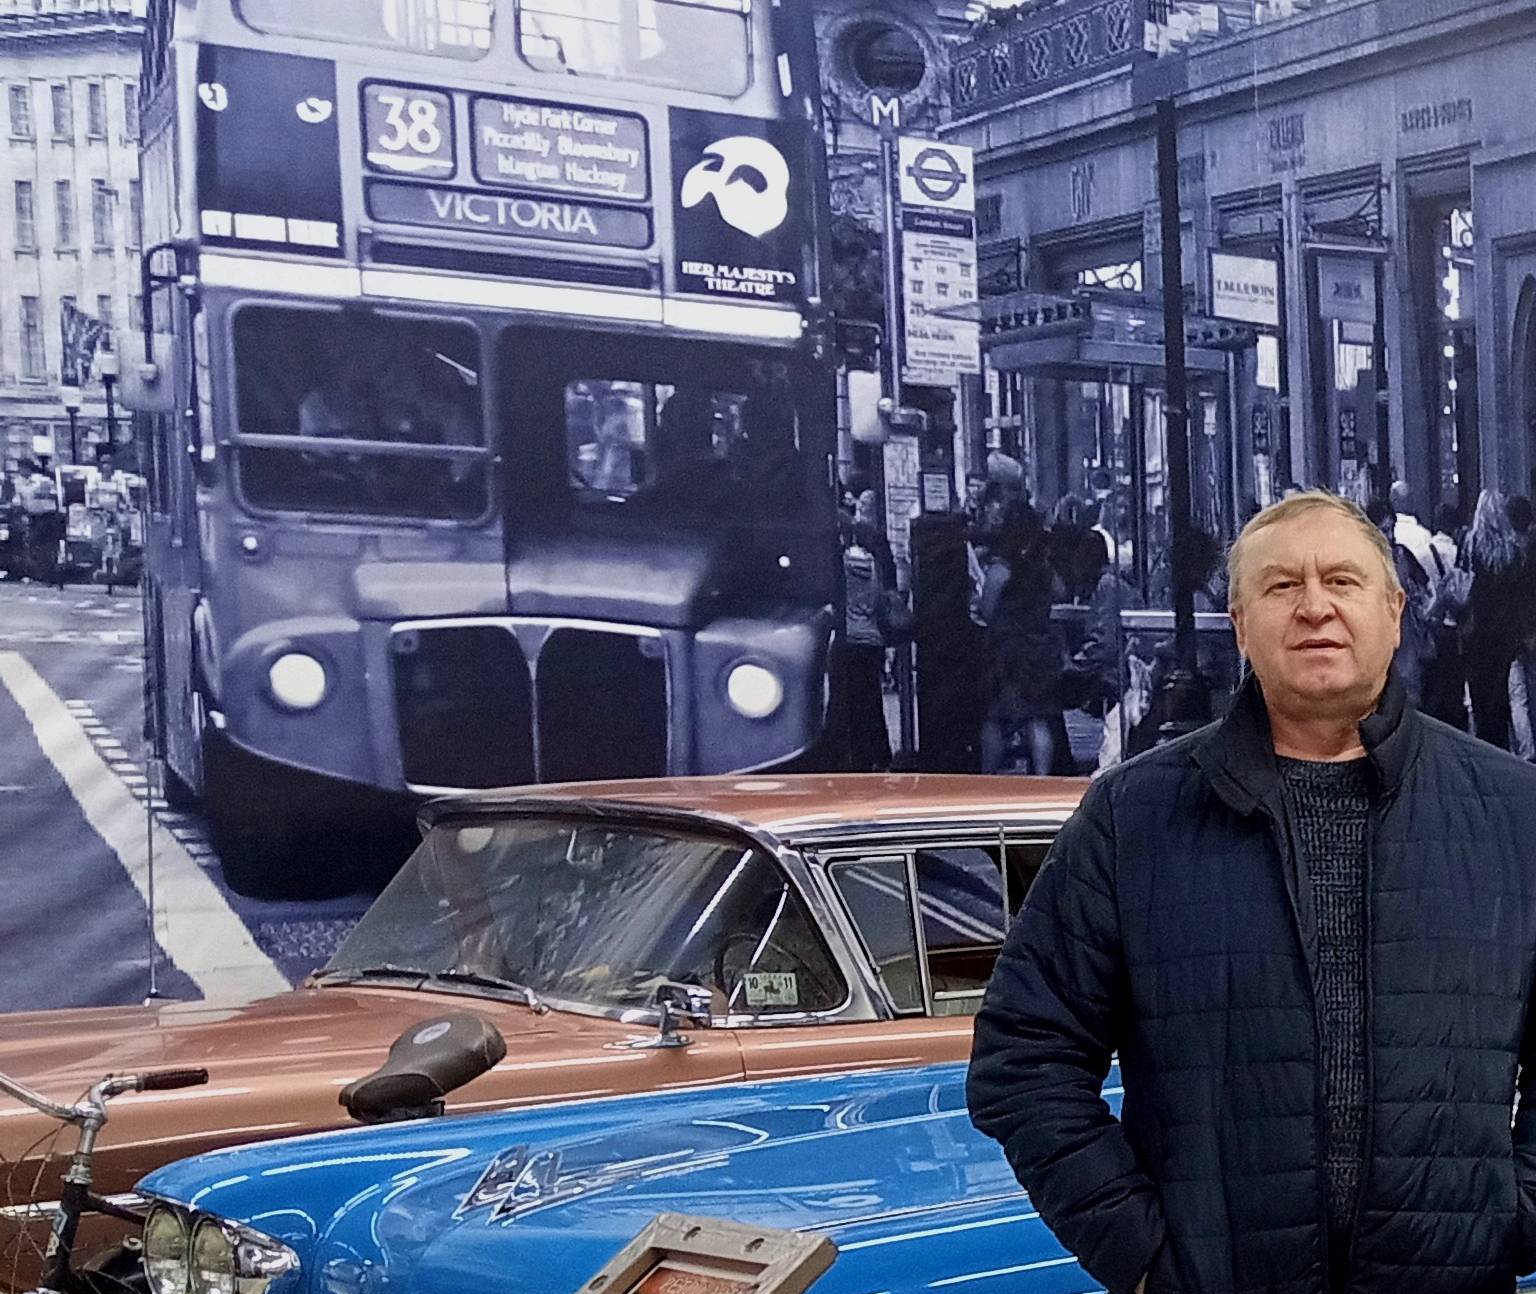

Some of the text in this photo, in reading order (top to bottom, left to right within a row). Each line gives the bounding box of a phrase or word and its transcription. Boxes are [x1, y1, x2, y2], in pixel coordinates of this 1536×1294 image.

[377, 95, 441, 153] 38
[502, 104, 618, 135] Hyde Park Corner
[871, 94, 900, 127] M
[565, 162, 627, 192] Hackney
[427, 189, 598, 236] VICTORIA
[682, 261, 715, 277] HER
[704, 277, 776, 296] THEATRE
